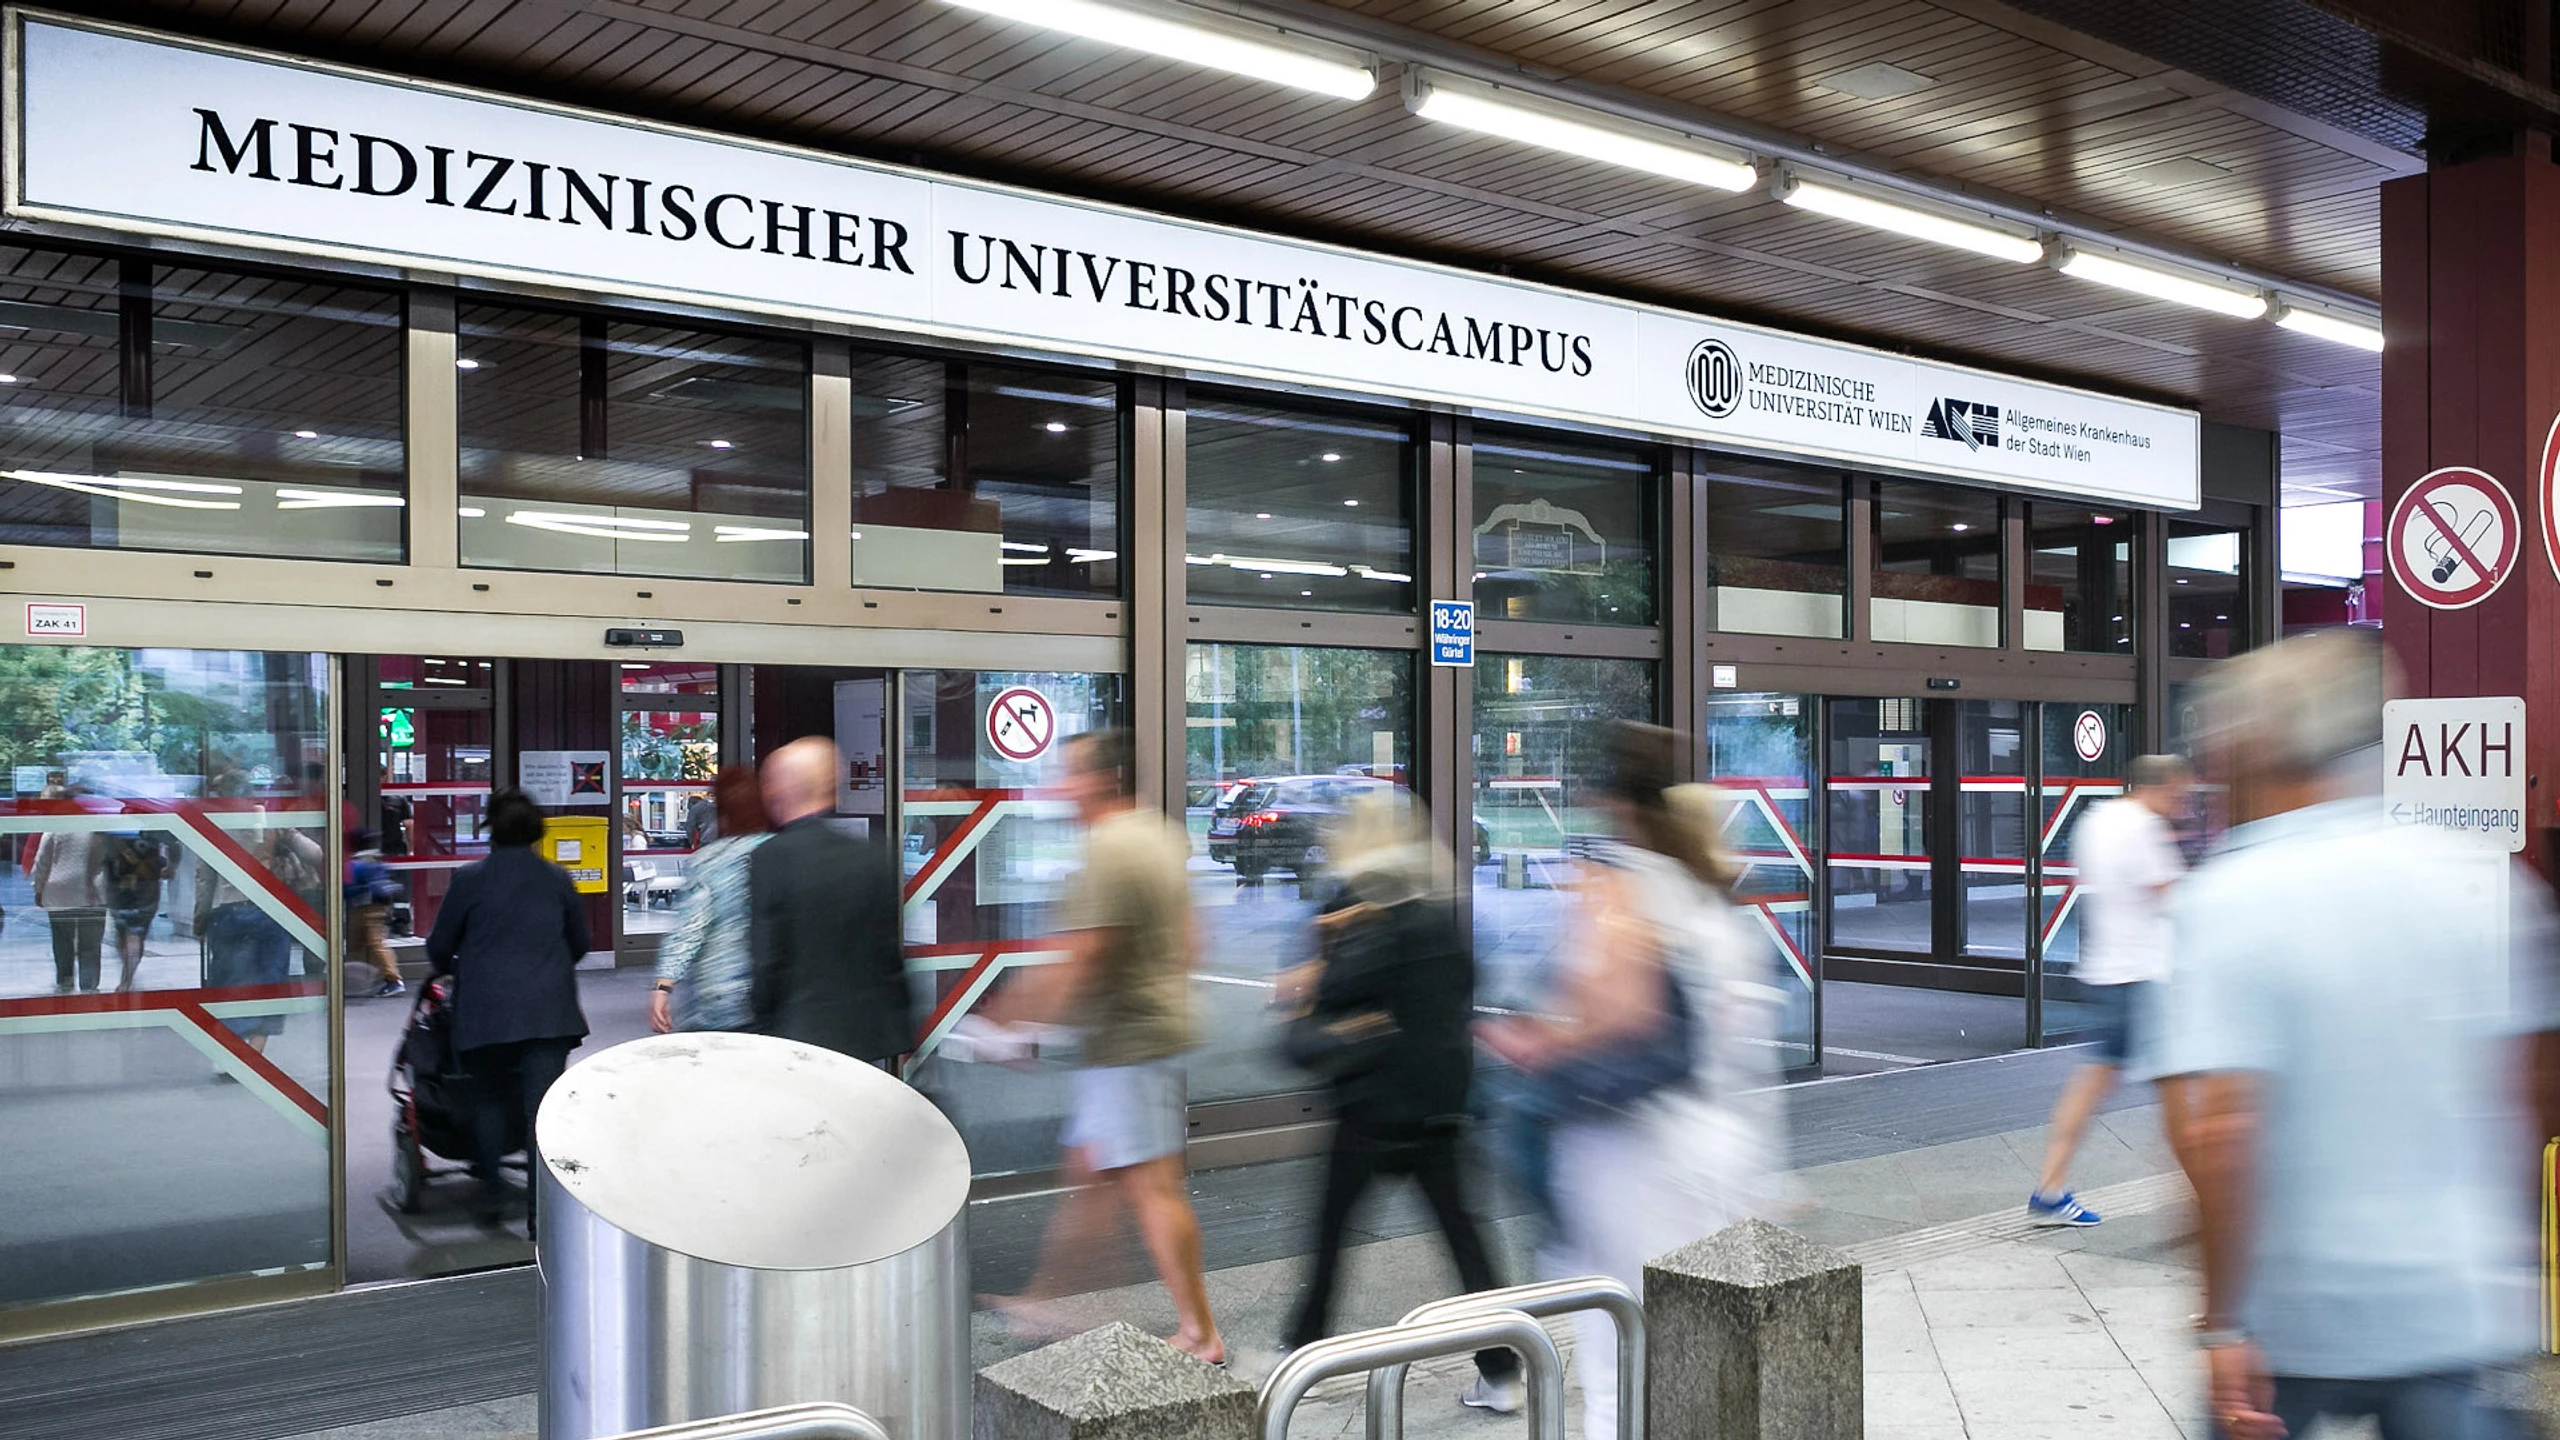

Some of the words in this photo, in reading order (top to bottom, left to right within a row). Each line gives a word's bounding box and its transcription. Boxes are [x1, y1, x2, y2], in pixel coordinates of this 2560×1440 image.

[190, 107, 916, 275] MEDIZINISCHER
[948, 230, 1593, 377] UNIVERSITÄTSCAMPUS
[1749, 361, 1876, 403] MEDIZINISCHE
[1749, 388, 1864, 427] UNIVERSITÄT
[1868, 409, 1913, 434] WIEN
[1920, 396, 1999, 453] AKH
[2006, 408, 2078, 436] Allgemeines
[2079, 421, 2151, 449] Krankenhaus
[2006, 437, 2026, 452] der
[2028, 437, 2061, 459] Stadt
[2063, 443, 2092, 463] Wien
[35, 618, 60, 628] ZAK
[1434, 608, 1471, 631] 18-20
[1434, 632, 1471, 647] Währinger
[1441, 646, 1464, 659] Gürtel
[2397, 722, 2512, 777] AKH
[2414, 801, 2519, 833] Haupteingang
